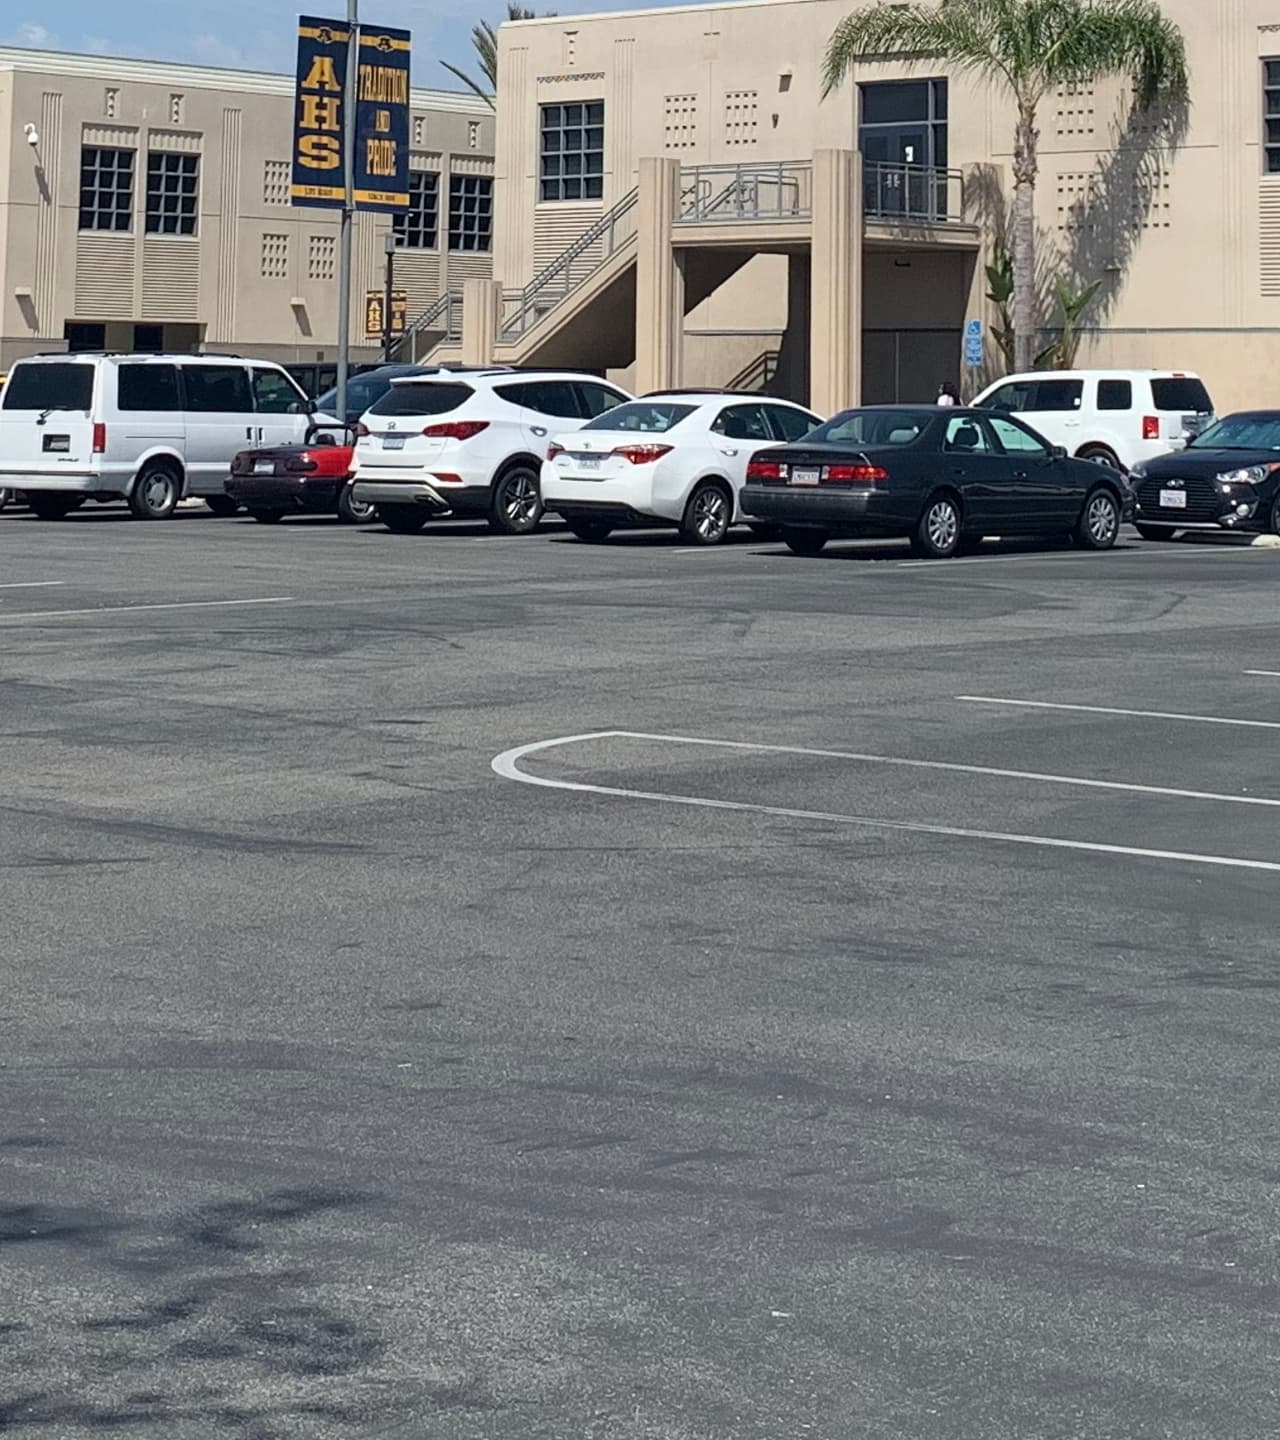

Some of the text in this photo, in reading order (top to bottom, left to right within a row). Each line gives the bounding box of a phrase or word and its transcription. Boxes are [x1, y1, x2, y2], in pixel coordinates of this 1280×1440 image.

[359, 64, 408, 104] TRADITION
[298, 56, 341, 170] AHS
[366, 139, 396, 176] PRIDE
